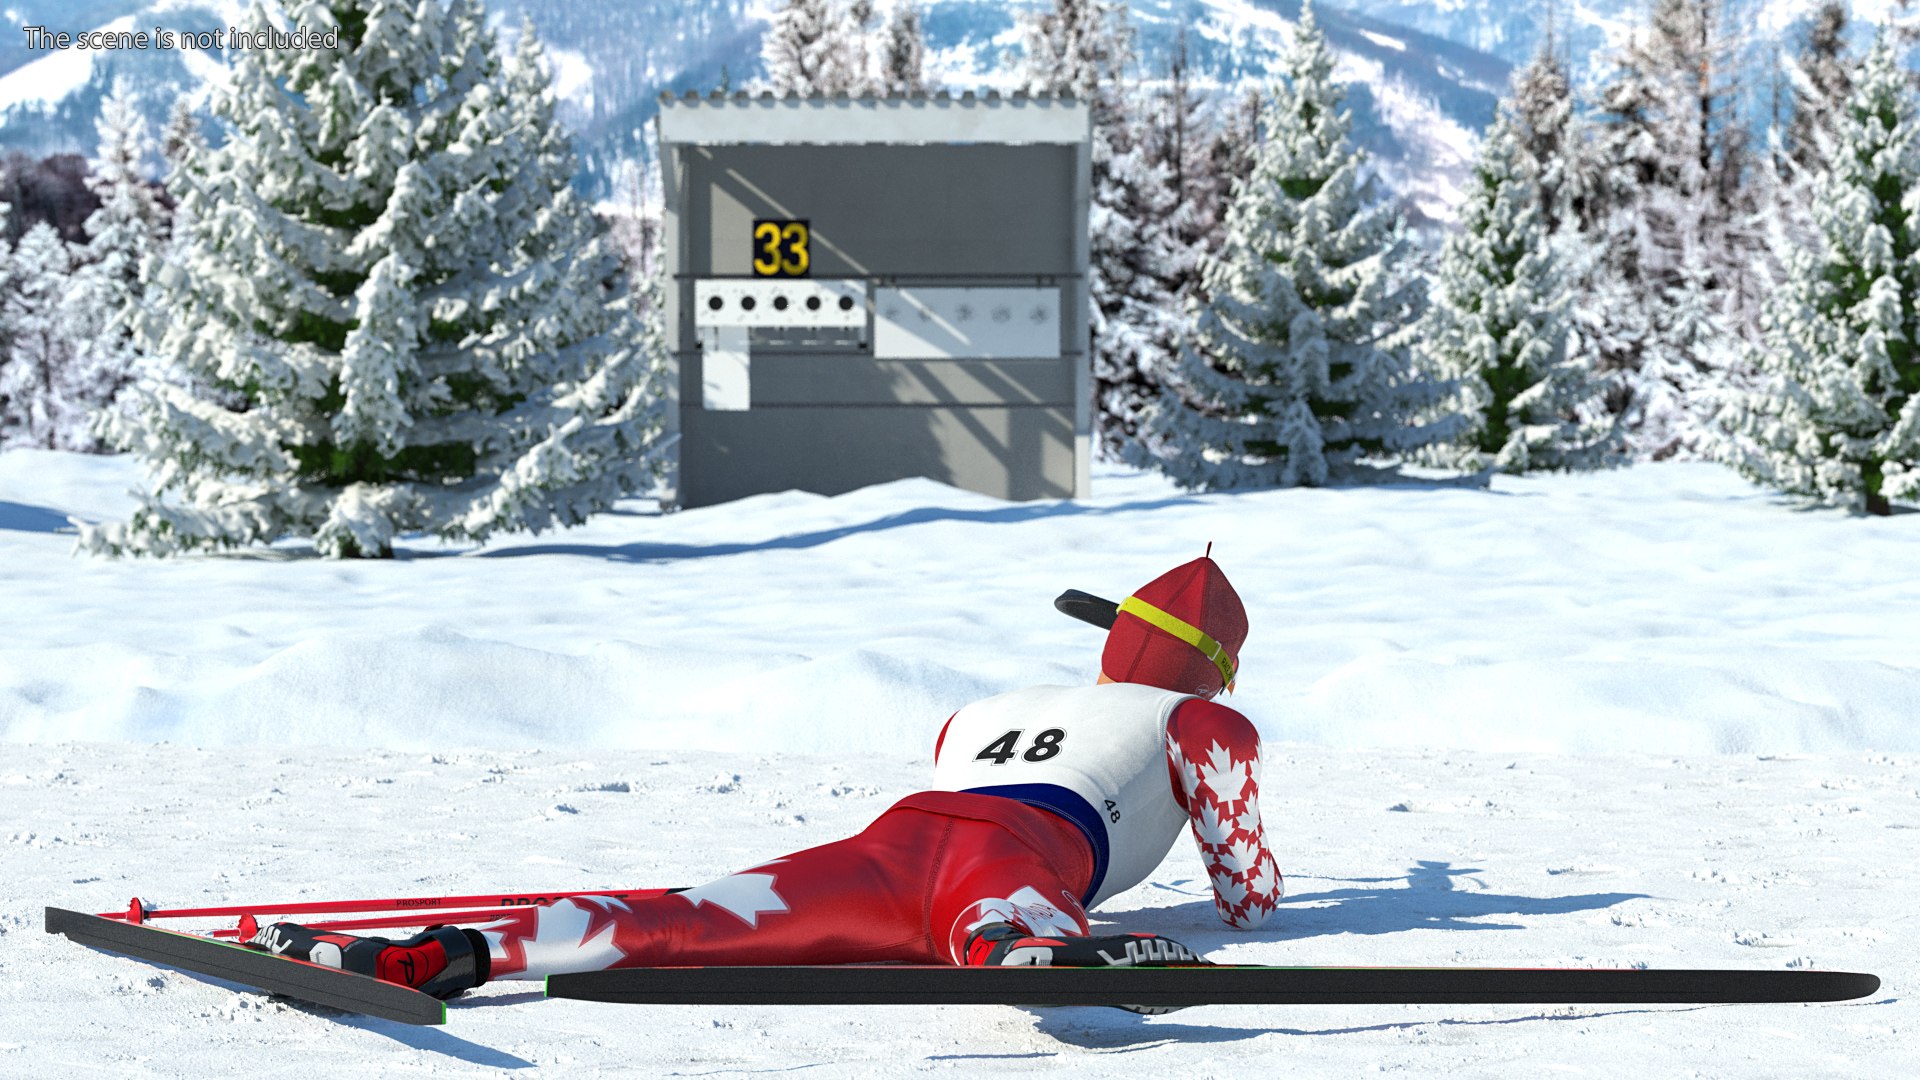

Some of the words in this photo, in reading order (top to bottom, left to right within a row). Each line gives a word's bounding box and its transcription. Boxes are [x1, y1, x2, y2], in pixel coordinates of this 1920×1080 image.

[753, 221, 810, 277] 33
[972, 726, 1068, 767] 48
[1104, 799, 1121, 824] 48
[396, 897, 442, 908] PROSPORT
